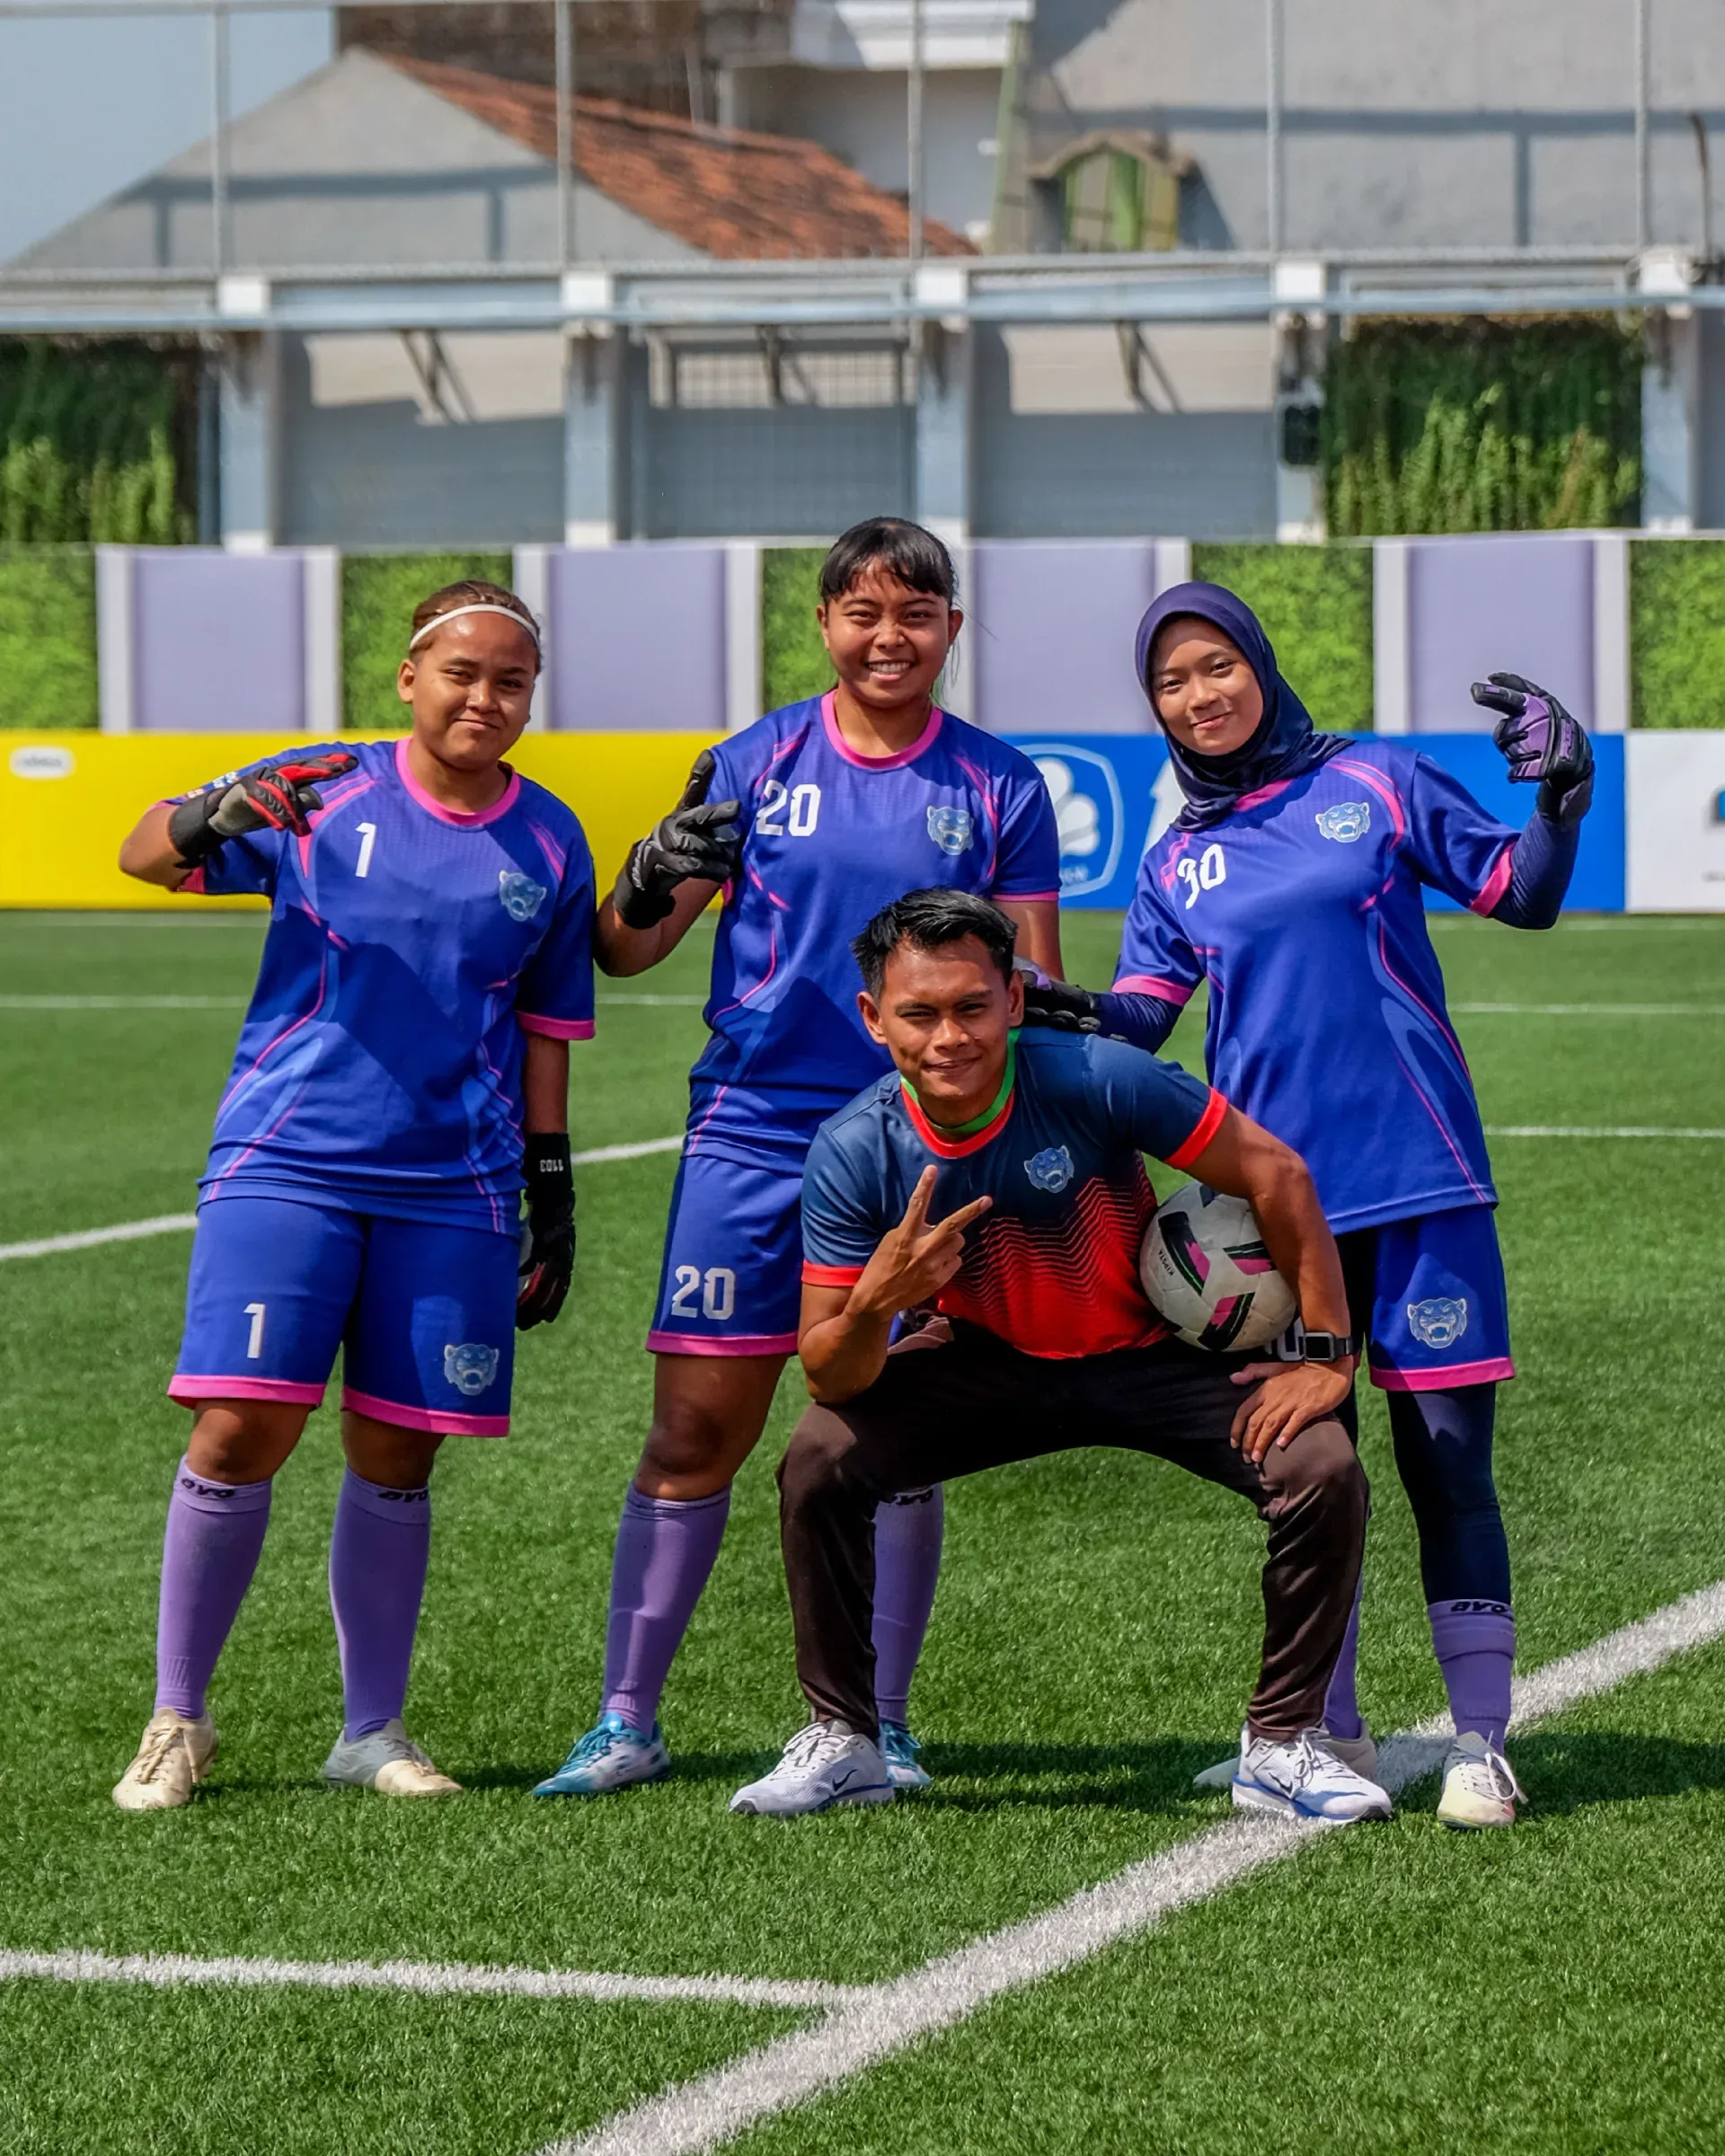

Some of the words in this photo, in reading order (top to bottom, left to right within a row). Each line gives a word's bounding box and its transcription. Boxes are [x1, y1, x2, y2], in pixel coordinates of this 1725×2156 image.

[756, 779, 822, 836] 20
[355, 822, 377, 878] 1
[1176, 843, 1226, 910] 30
[670, 1265, 737, 1321] 20
[243, 1303, 267, 1359] 1
